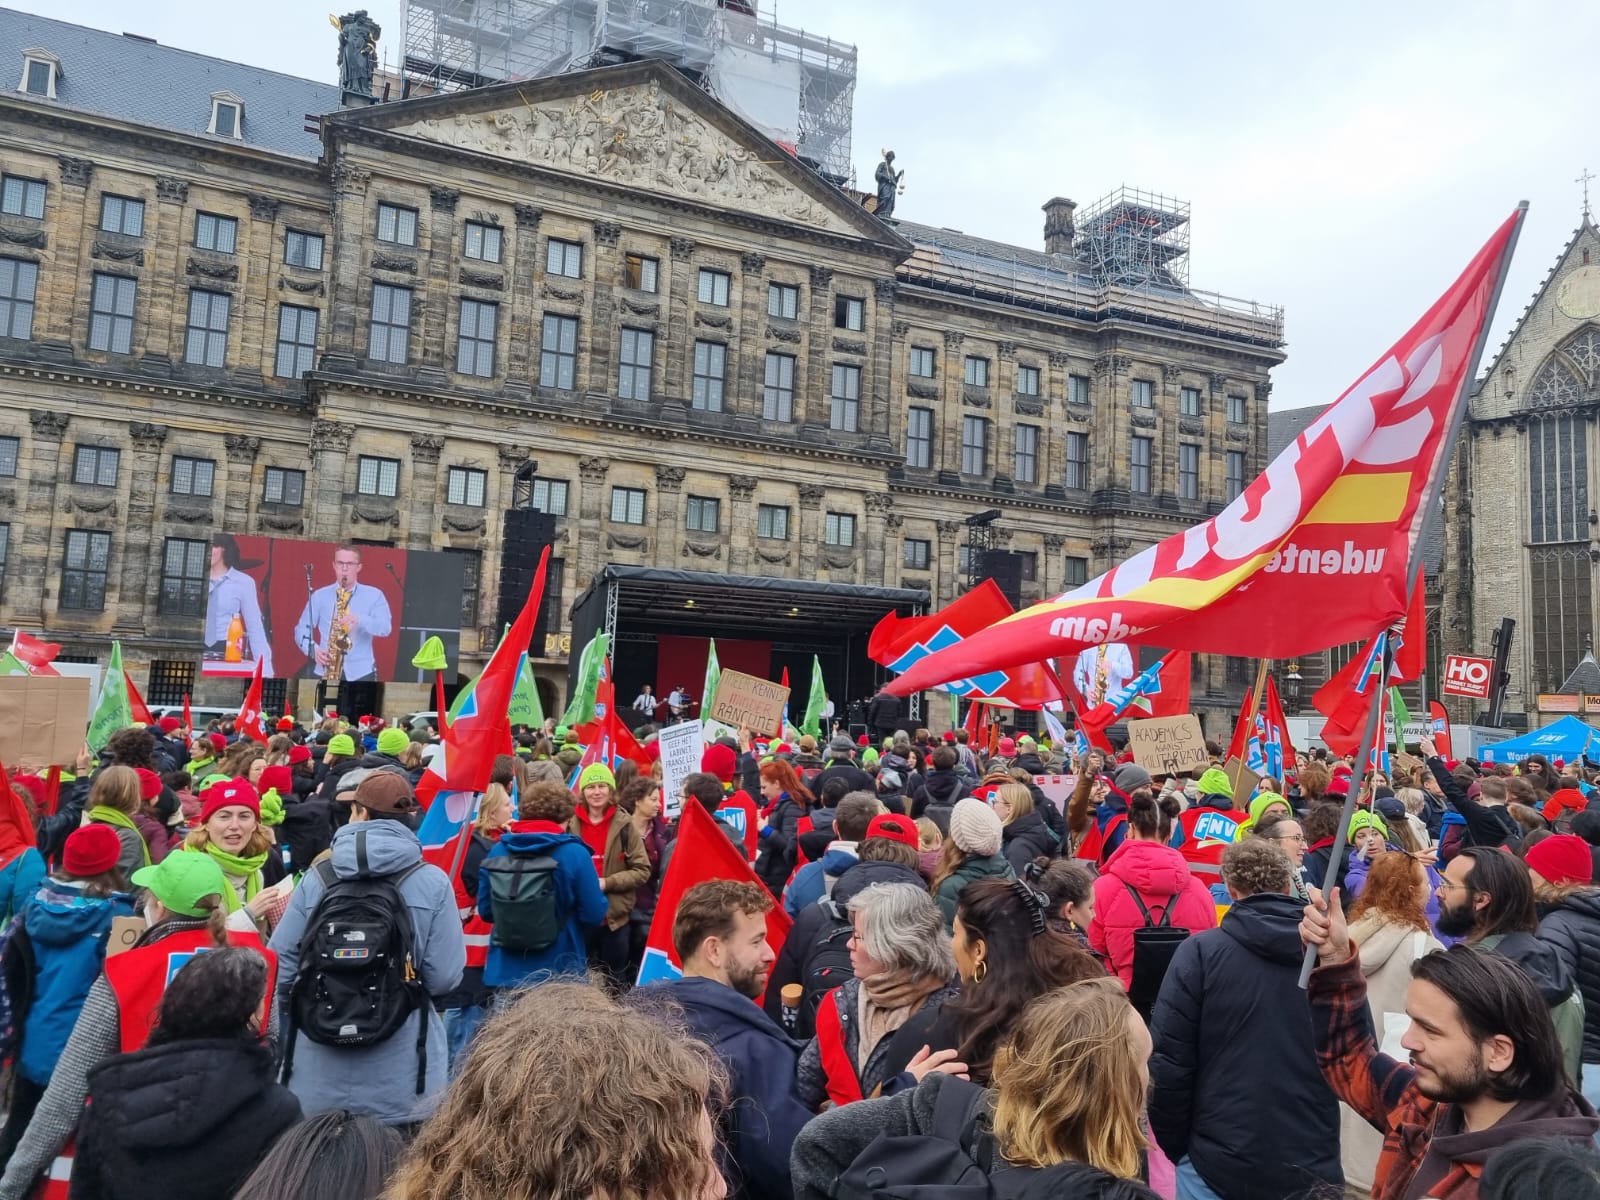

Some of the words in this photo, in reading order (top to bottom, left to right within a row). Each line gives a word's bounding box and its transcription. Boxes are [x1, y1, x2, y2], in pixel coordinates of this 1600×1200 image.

[1448, 659, 1488, 683] HO
[752, 682, 784, 701] KENNIS
[1135, 723, 1192, 743] ACADEMICS
[1507, 751, 1528, 761] Word
[1197, 818, 1236, 837] FNV
